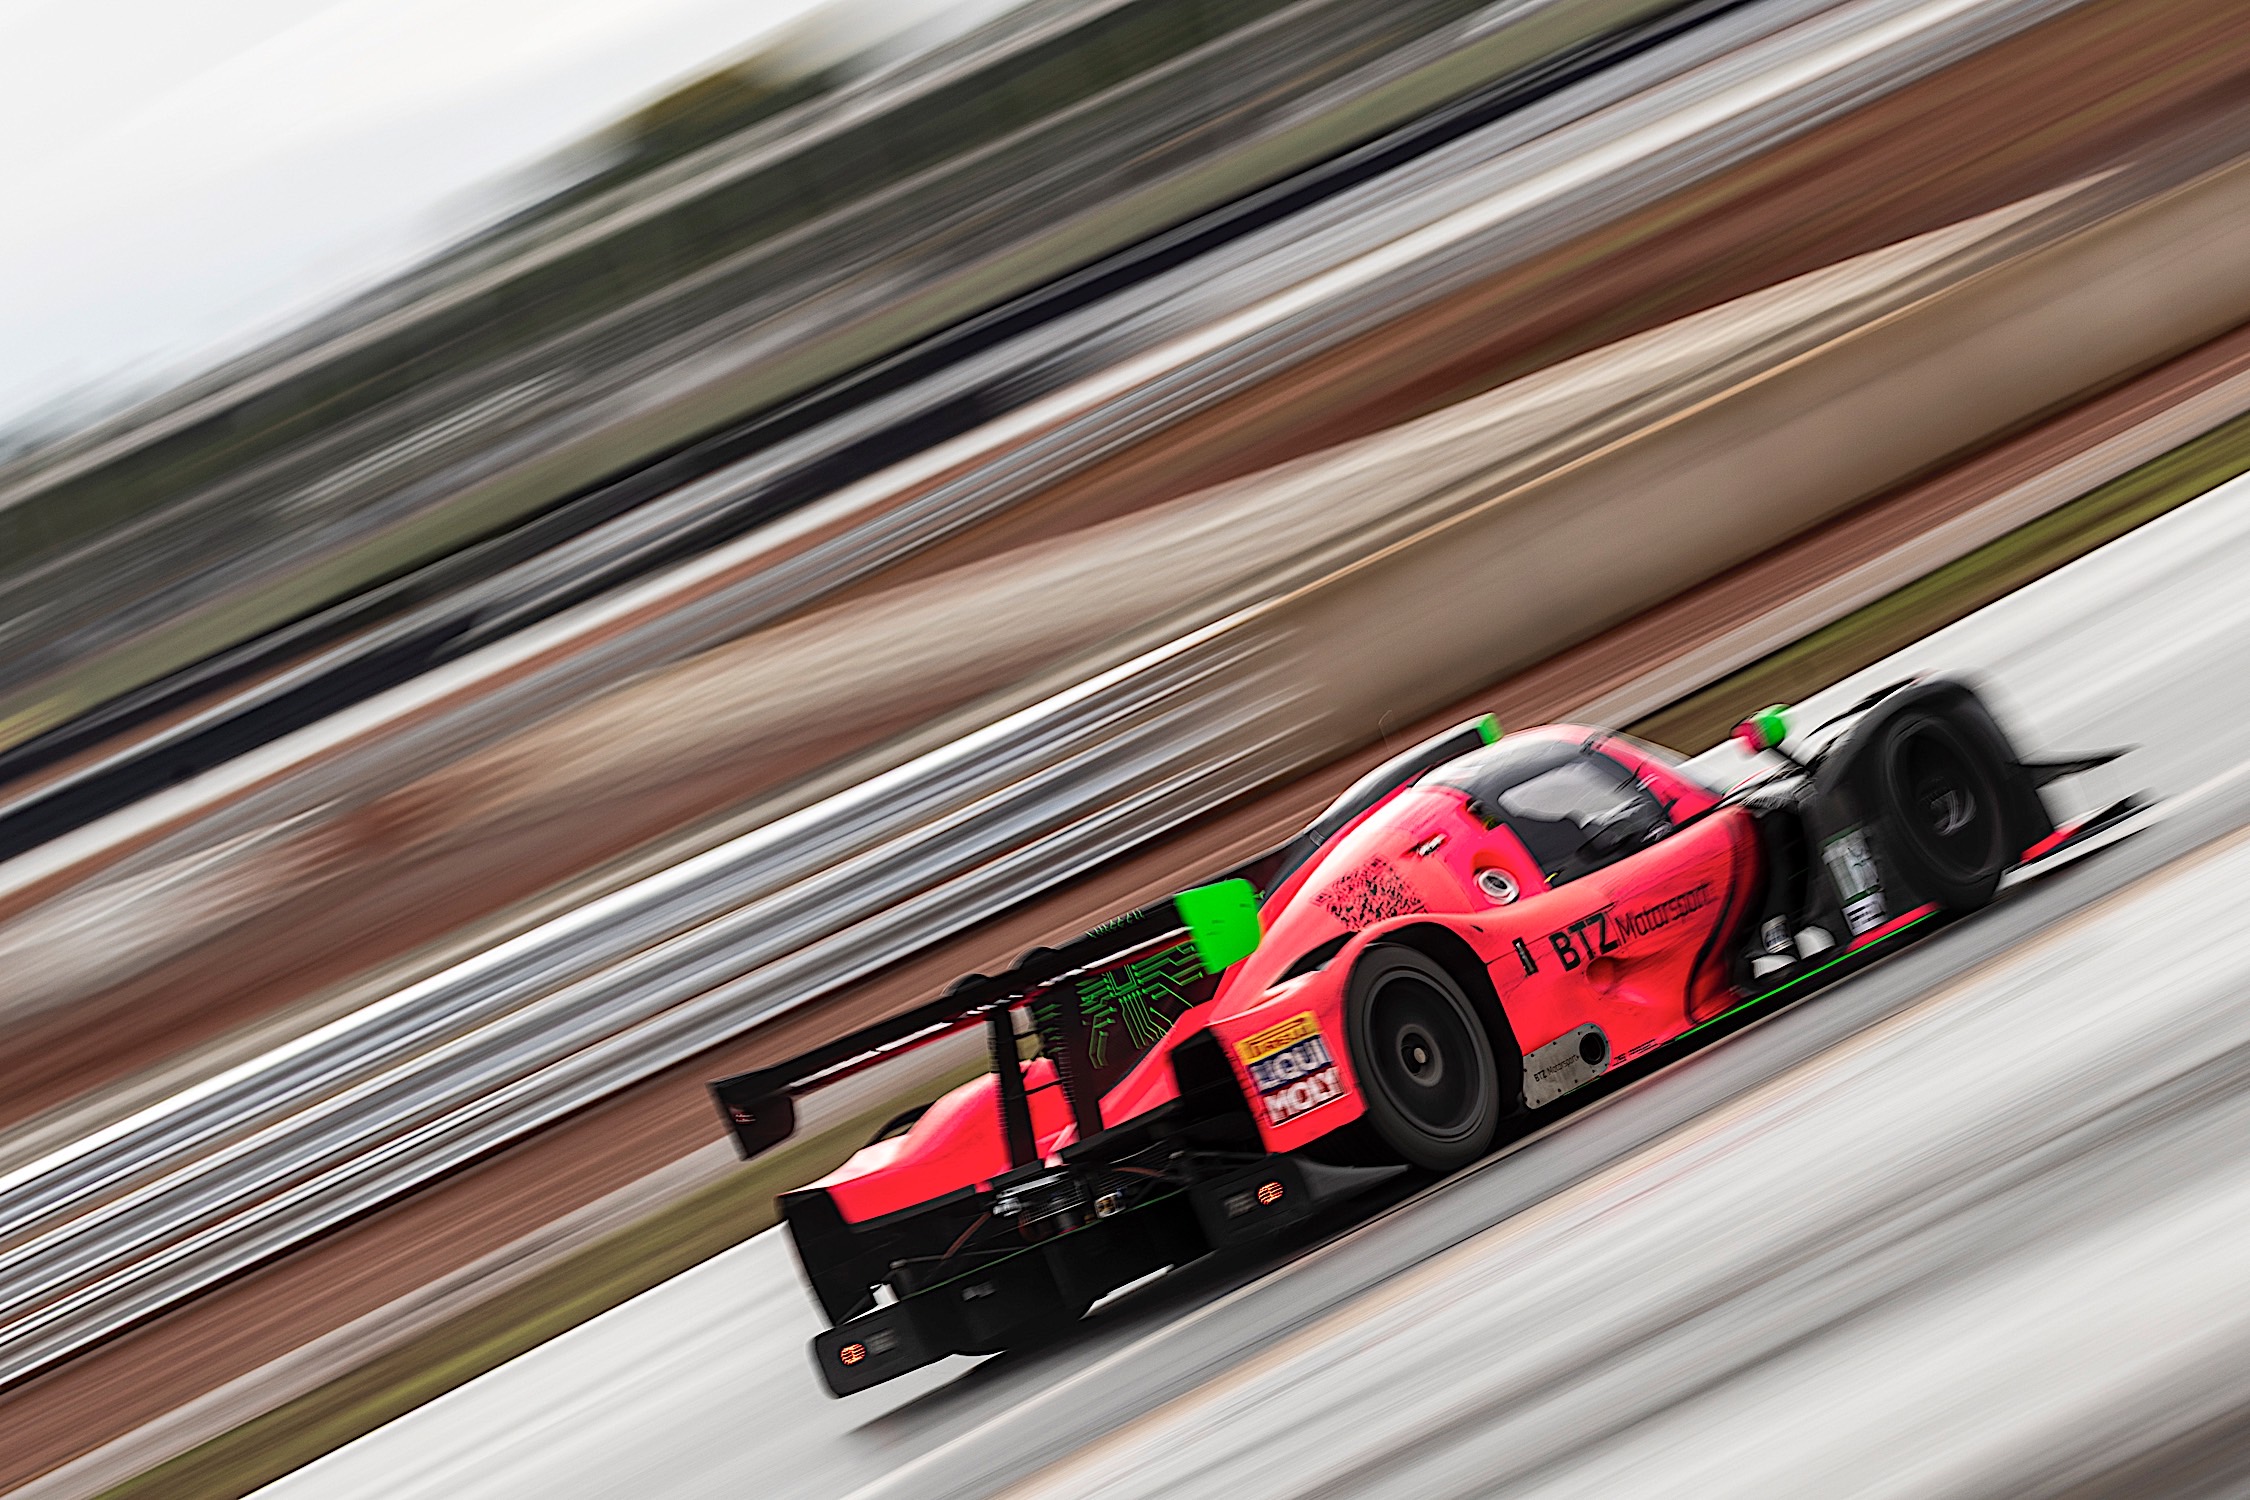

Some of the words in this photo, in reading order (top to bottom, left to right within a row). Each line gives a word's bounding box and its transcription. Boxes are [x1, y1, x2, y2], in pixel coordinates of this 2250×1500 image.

[1549, 912, 1619, 972] BTZ
[1615, 883, 1714, 944] Motorsport
[1263, 1067, 1342, 1122] MOLY
[1533, 1069, 1548, 1082] BTZ
